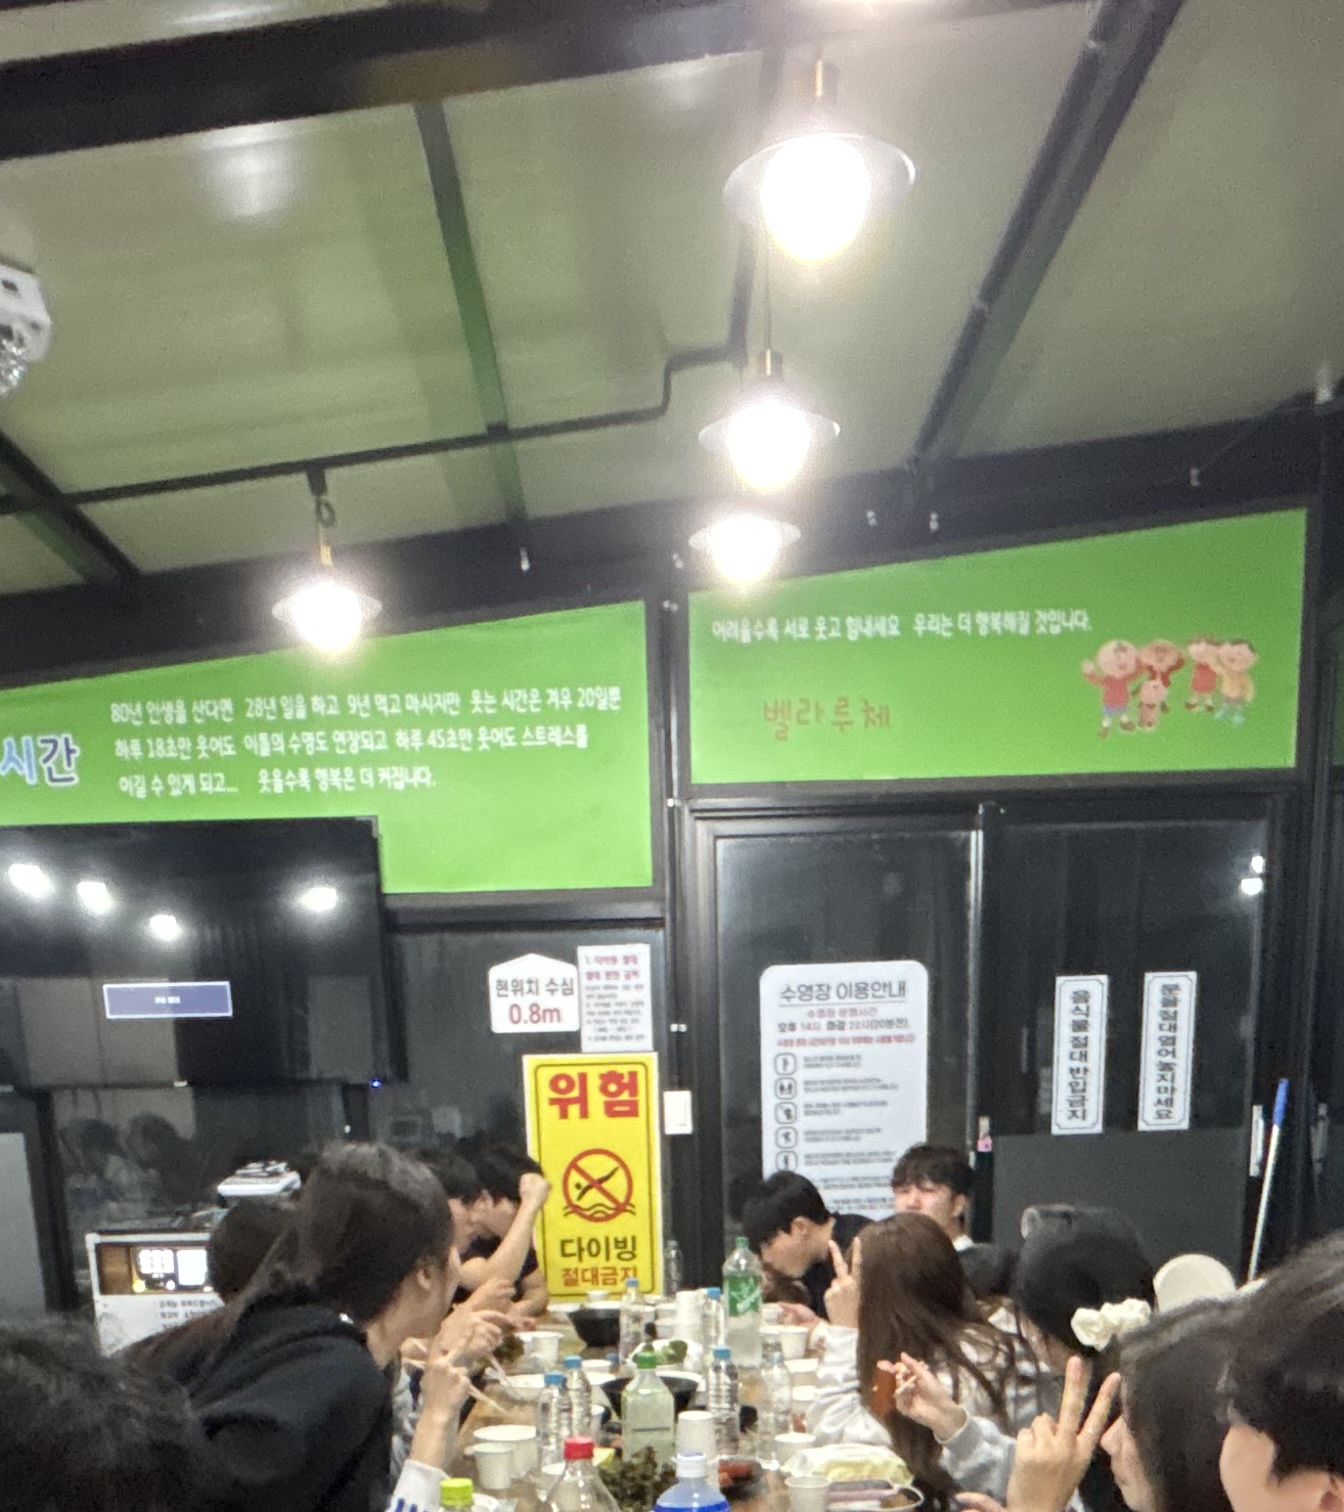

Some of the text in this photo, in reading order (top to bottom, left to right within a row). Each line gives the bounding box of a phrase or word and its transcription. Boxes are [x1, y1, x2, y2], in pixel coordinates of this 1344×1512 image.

[784, 616, 810, 640] 서로
[815, 615, 842, 640] 웃고
[845, 614, 901, 641] 힘내세요
[913, 612, 954, 638] 우리는
[958, 611, 972, 636] 더
[975, 610, 1030, 636] 행복해질
[110, 702, 143, 726] 80년
[146, 699, 187, 725] 인생을
[192, 698, 234, 723] 산다면
[281, 693, 306, 720] 일을
[311, 695, 340, 717] 하고
[347, 693, 371, 718] 9년
[374, 693, 401, 717] 먹고
[406, 691, 460, 716] 마시지만
[471, 689, 497, 714] 웃는
[502, 688, 542, 713] 시간은
[547, 687, 573, 711] 겨우
[763, 696, 891, 742] 벨라루체
[114, 738, 143, 760] 하루
[146, 736, 191, 760] 18초만
[197, 735, 236, 760] 웃어도
[332, 730, 389, 755] 연장되고
[395, 727, 423, 752] 하루
[427, 727, 472, 752] 45초만
[477, 725, 517, 751] 웃어도
[521, 723, 588, 749] 스트레스를
[119, 774, 146, 799] 이길
[151, 774, 163, 798] 수
[167, 772, 196, 797] 있게
[259, 768, 310, 794] 웃을수록
[314, 766, 356, 792] 행복은
[360, 767, 374, 789] 더
[378, 765, 437, 790] 커집니다.
[495, 976, 575, 998] 현위치 수심
[780, 980, 906, 1002] 수영장 이용안내
[509, 1003, 561, 1025] 0.8m
[548, 1070, 640, 1120] 위험
[559, 1236, 638, 1263] 다이빙
